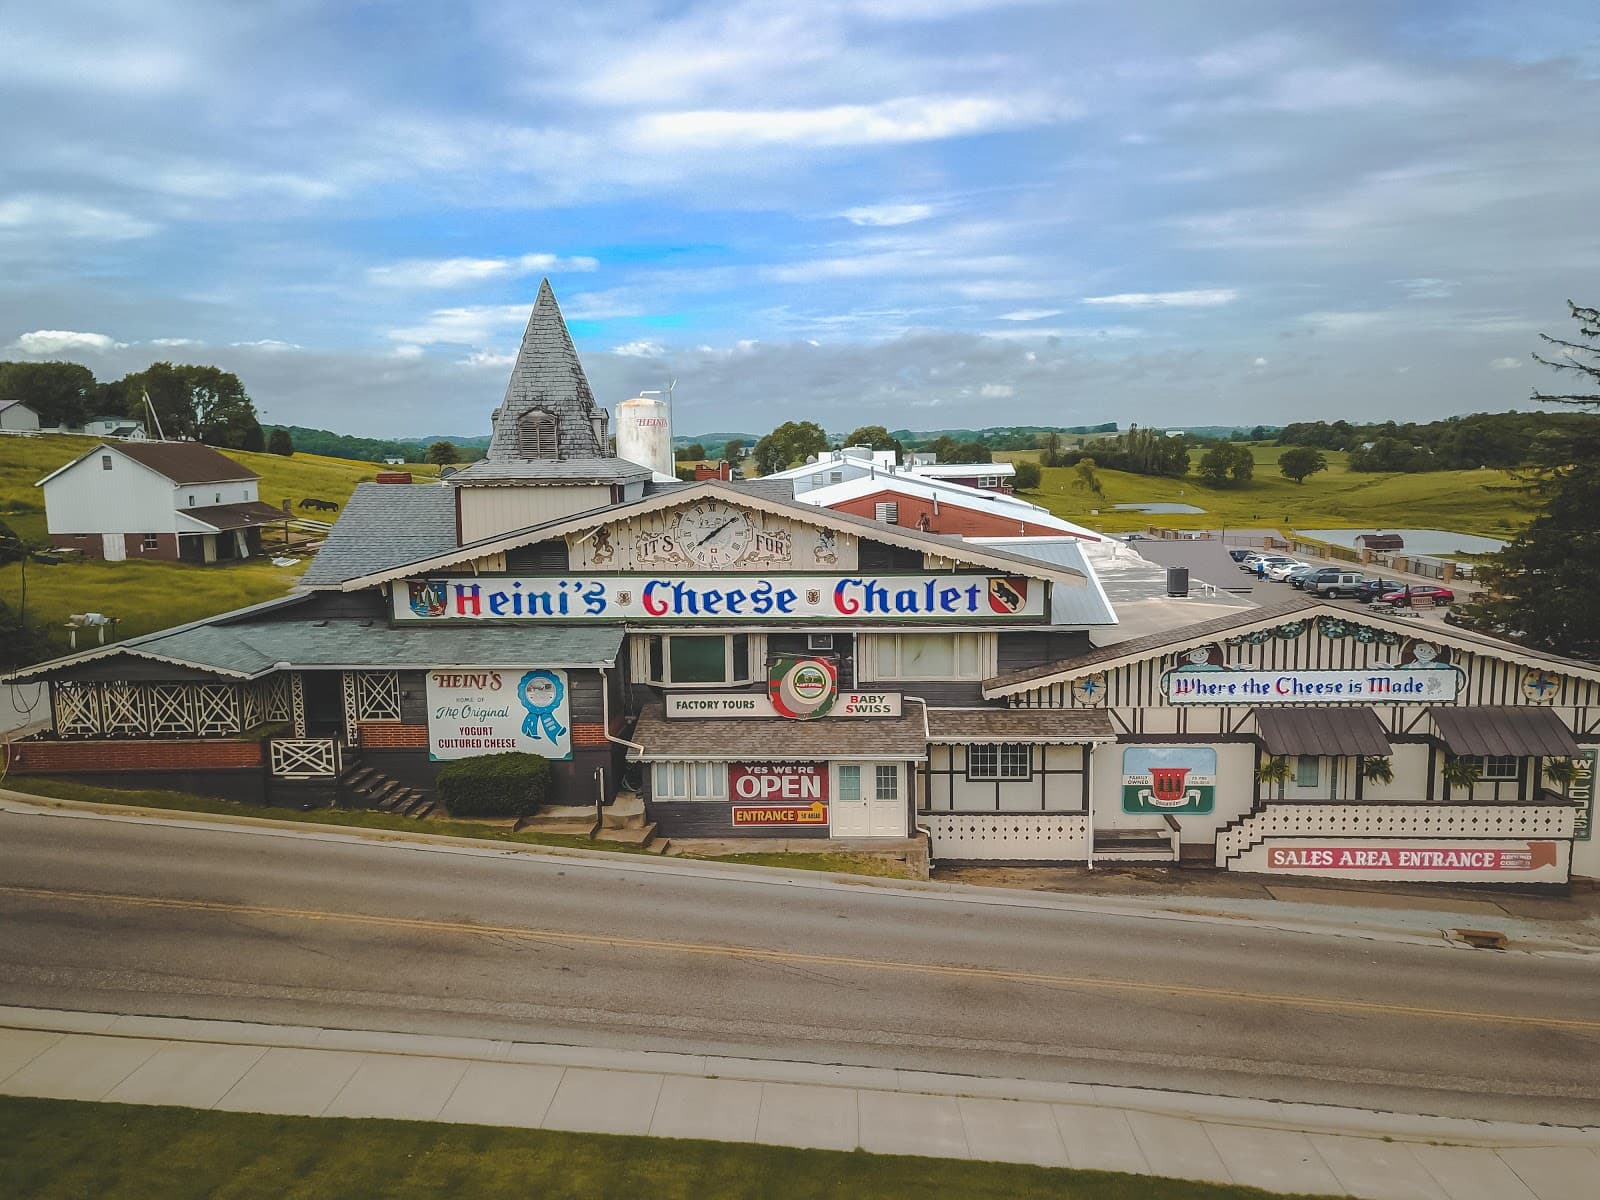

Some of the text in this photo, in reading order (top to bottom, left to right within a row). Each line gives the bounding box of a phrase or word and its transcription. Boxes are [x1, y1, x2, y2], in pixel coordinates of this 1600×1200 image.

[643, 535, 673, 556] IT'S
[755, 534, 785, 554] FOR
[454, 578, 982, 616] Heini's Cheese Chalet
[432, 670, 502, 690] HEINI'S
[1175, 676, 1424, 696] Where the Cheese is Made
[676, 700, 755, 710] FACTORY TOURS
[850, 695, 886, 704] BABY
[436, 704, 510, 722] The Original
[845, 704, 891, 713] SWISS
[459, 726, 493, 736] YOGURT
[438, 738, 516, 748] CULTURED CHEESE
[745, 766, 814, 774] YES WE'RE
[736, 775, 821, 798] OPEN
[736, 810, 795, 821] ENTRANCE
[1273, 851, 1495, 868] SALES AREA ENTRANCE
